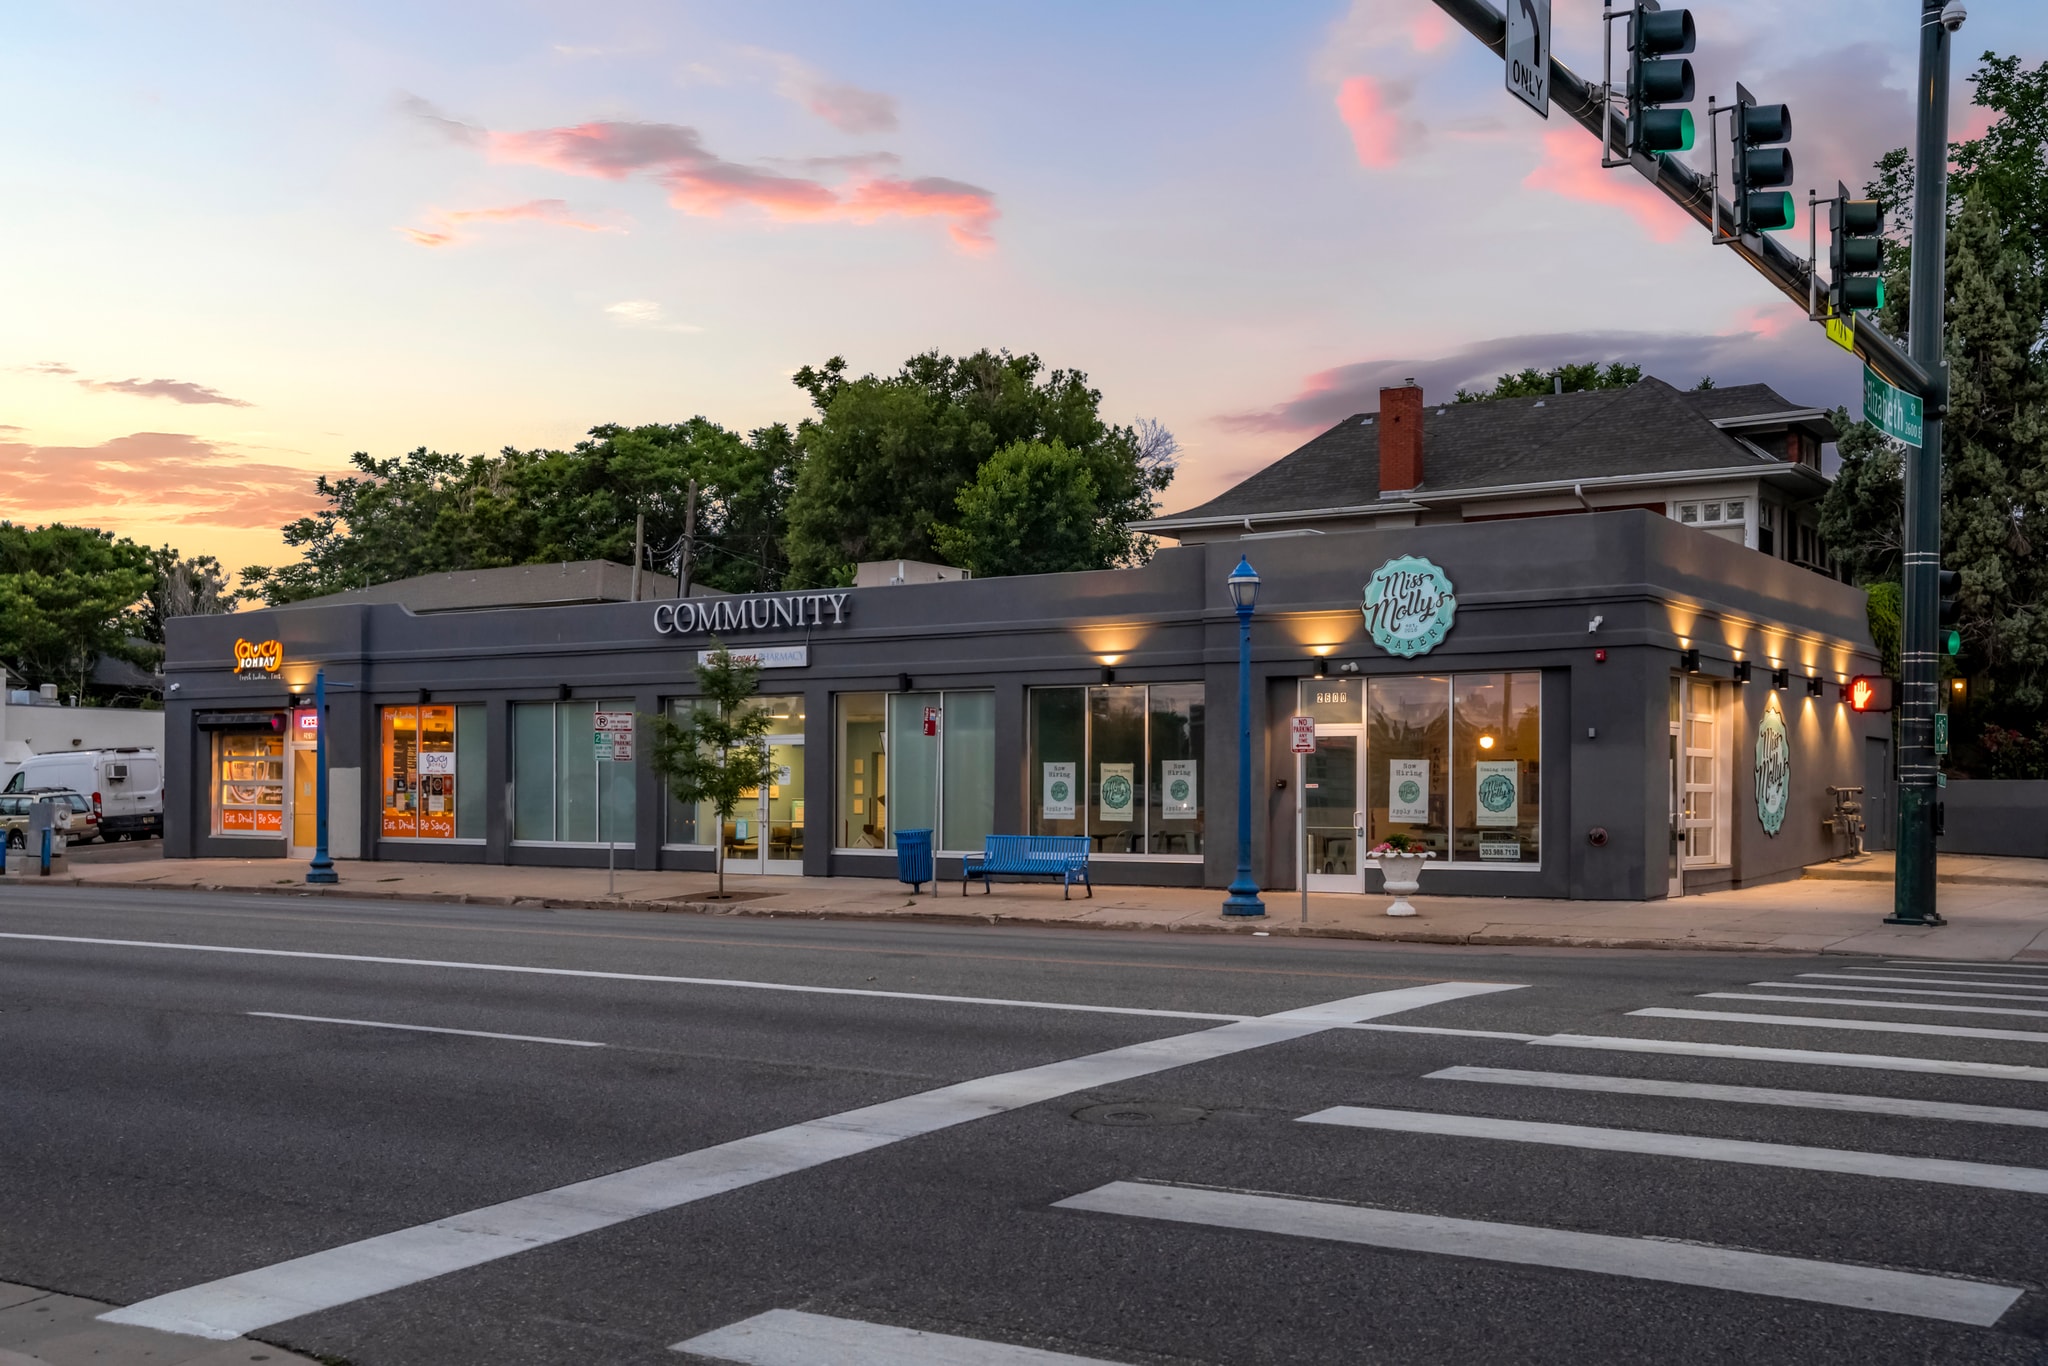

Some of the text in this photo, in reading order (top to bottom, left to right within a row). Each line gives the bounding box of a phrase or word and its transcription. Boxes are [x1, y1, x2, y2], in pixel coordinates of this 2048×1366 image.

[1513, 59, 1543, 101] ONLY
[1867, 380, 1904, 432] Elizabeth
[1911, 403, 1916, 416] St
[1905, 421, 1918, 438] 2600
[1377, 571, 1434, 599] Miss
[654, 594, 850, 634] COMMUNITY
[1363, 587, 1453, 634] Molly's
[1383, 618, 1445, 650] BAKERY
[234, 638, 283, 673] Saucy
[240, 657, 275, 668] BOMBAY
[759, 651, 804, 662] PHARMACY
[1317, 693, 1347, 703] 2600
[1167, 769, 1191, 777] Hiring
[1395, 770, 1423, 778] Hiring
[258, 814, 267, 824] Be
[420, 819, 429, 831] Be
